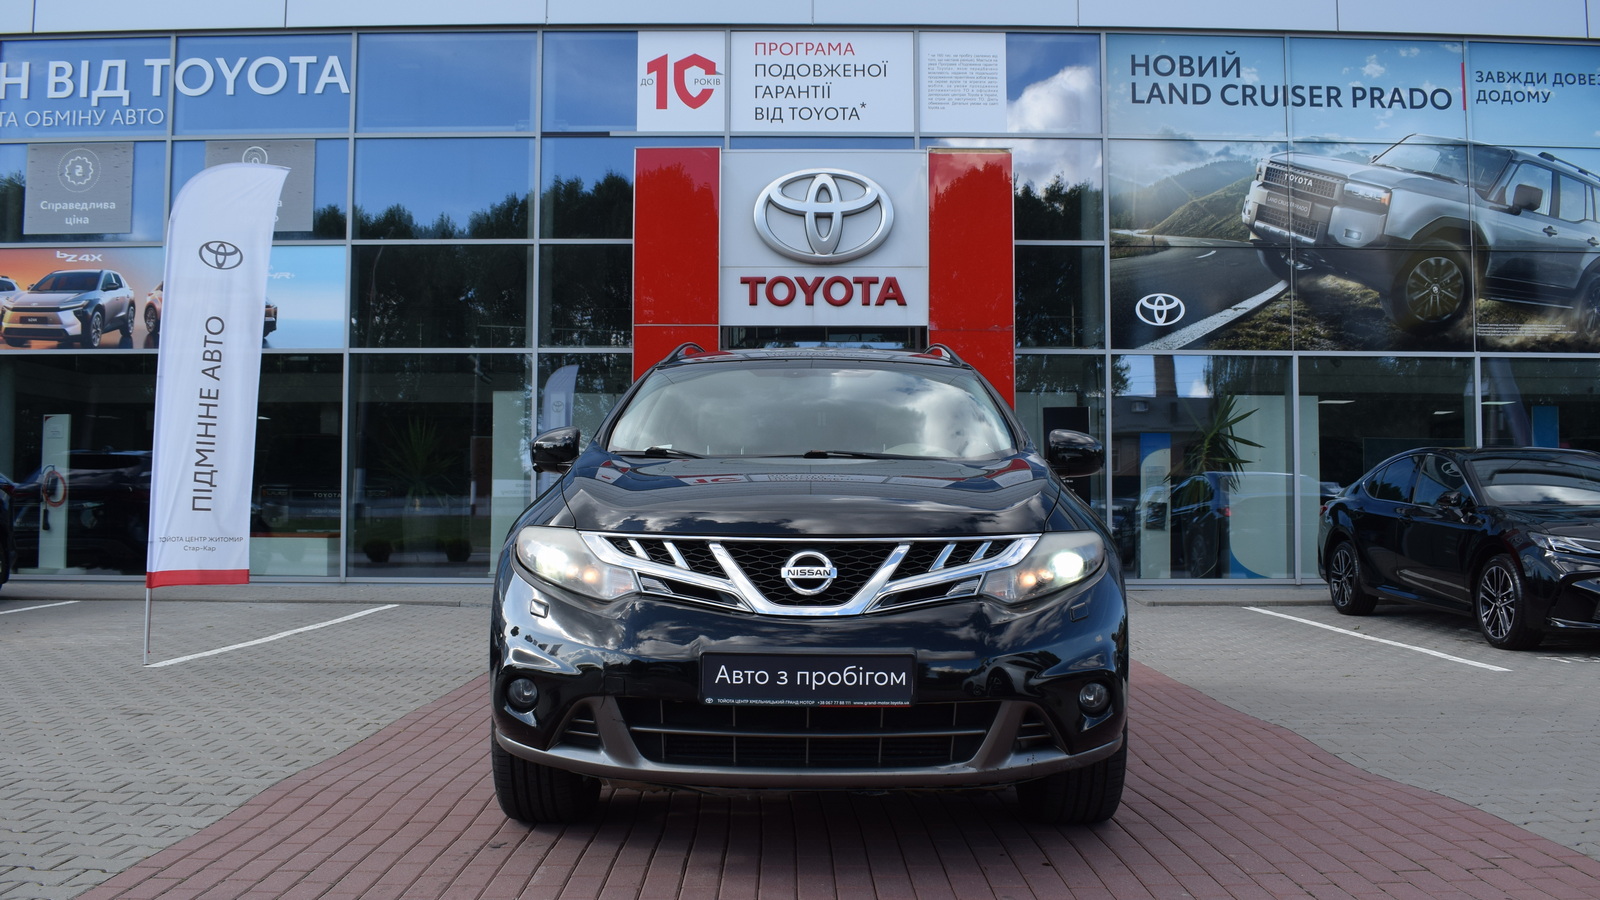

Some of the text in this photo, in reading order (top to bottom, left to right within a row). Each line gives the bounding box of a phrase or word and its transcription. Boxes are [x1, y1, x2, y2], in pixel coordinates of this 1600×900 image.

[754, 42, 855, 56] ПРОГРАМА
[754, 61, 889, 80] ПОДОВЖЕНОЇ
[1130, 50, 1241, 78] НОВИЙ
[47, 60, 130, 106] ВІД
[144, 56, 350, 97] TOYOTA
[640, 78, 654, 87] ДО
[694, 78, 721, 86] РОКІВ
[1475, 70, 1548, 86] ЗАВЖДИ
[754, 82, 831, 99] ГАРАНТІЇ
[1131, 82, 1453, 110] LAND CRUISER PRADO
[1475, 89, 1551, 105] ДОДОМУ
[24, 109, 106, 127] ОБМІНУ
[110, 108, 164, 126] АВТО
[754, 106, 784, 123] ВІД
[1285, 174, 1312, 186] TOYOTA
[39, 200, 117, 212] Справедлива
[65, 214, 90, 226] ціна
[740, 275, 907, 307] TOYOTA
[192, 316, 225, 511] ПІДМІННЕ АВТО
[185, 536, 207, 544] ЦЕНТР
[715, 665, 906, 690] Авто з пробігом
